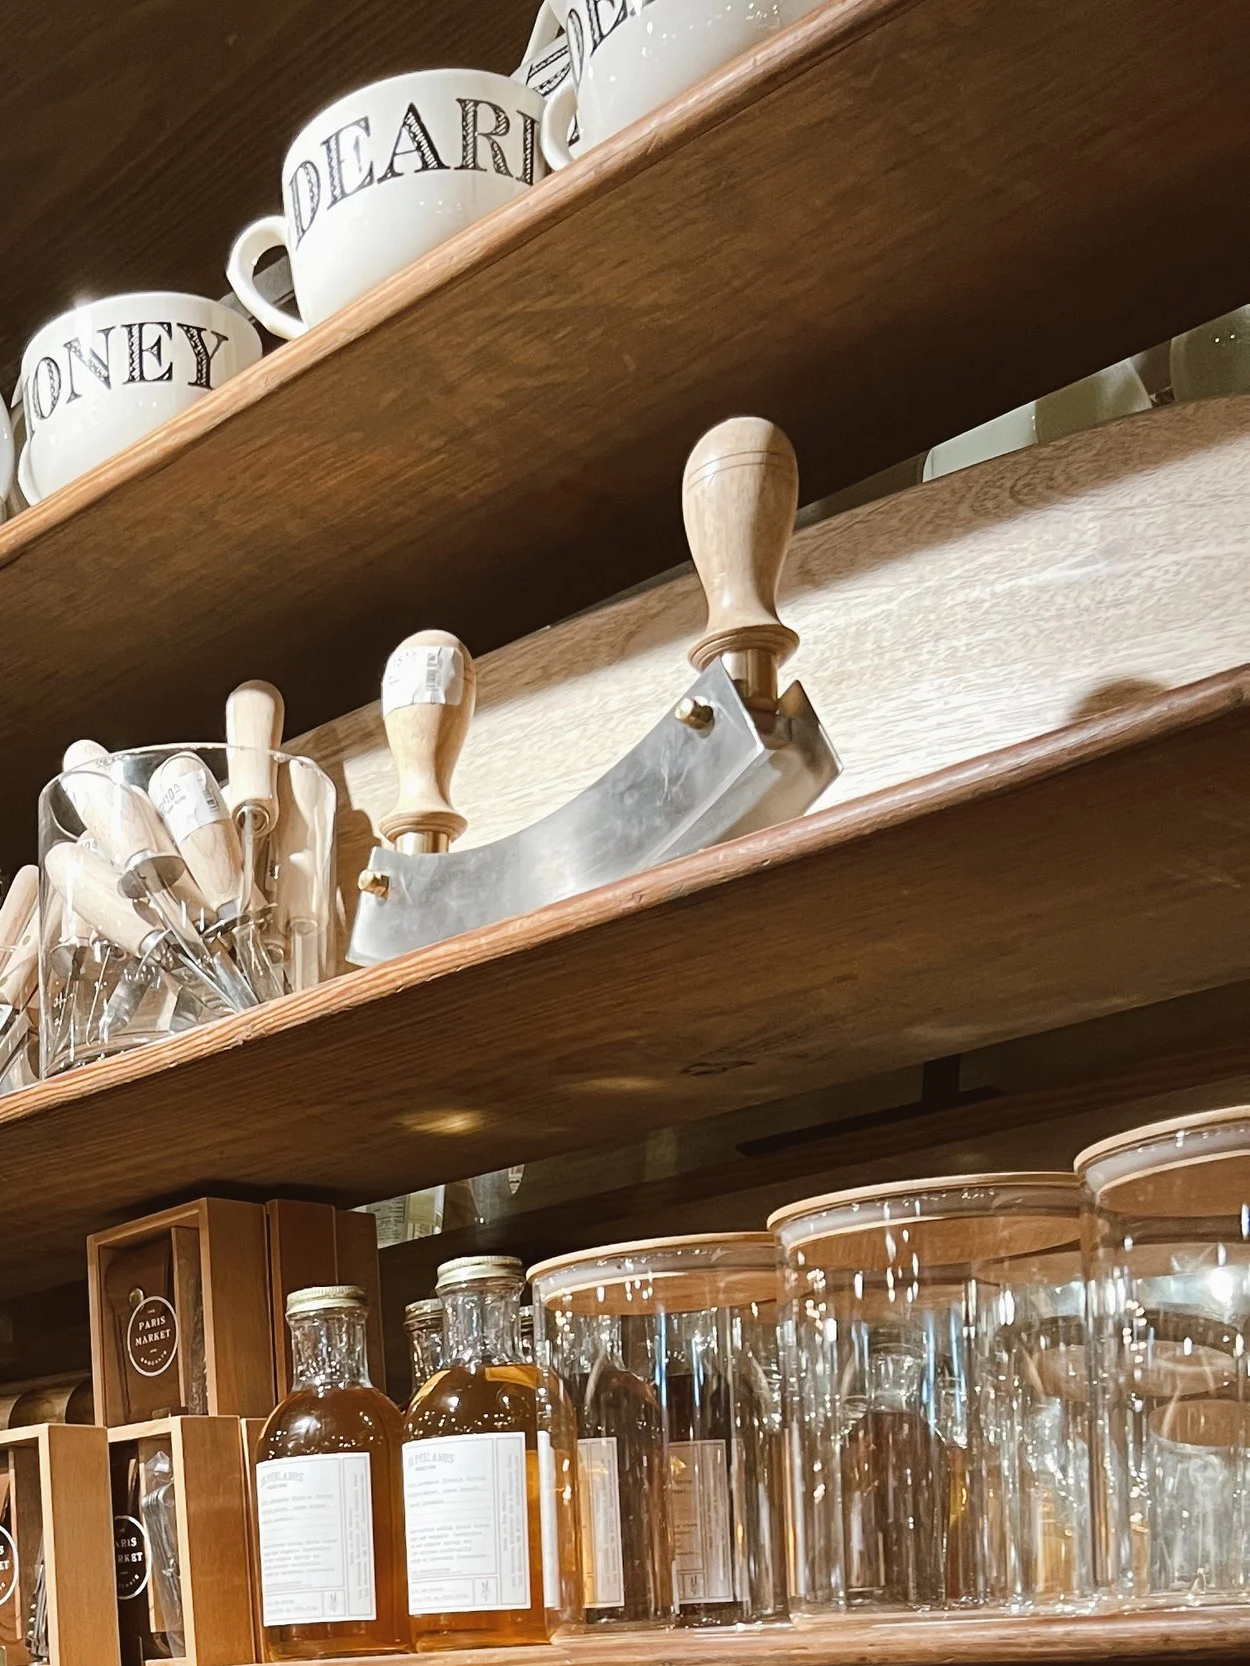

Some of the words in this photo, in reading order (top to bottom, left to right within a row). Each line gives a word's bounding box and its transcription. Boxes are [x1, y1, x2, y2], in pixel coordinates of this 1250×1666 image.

[22, 322, 228, 438] ONEY
[138, 1315, 166, 1331] PARIS
[135, 1328, 171, 1346] MARKET
